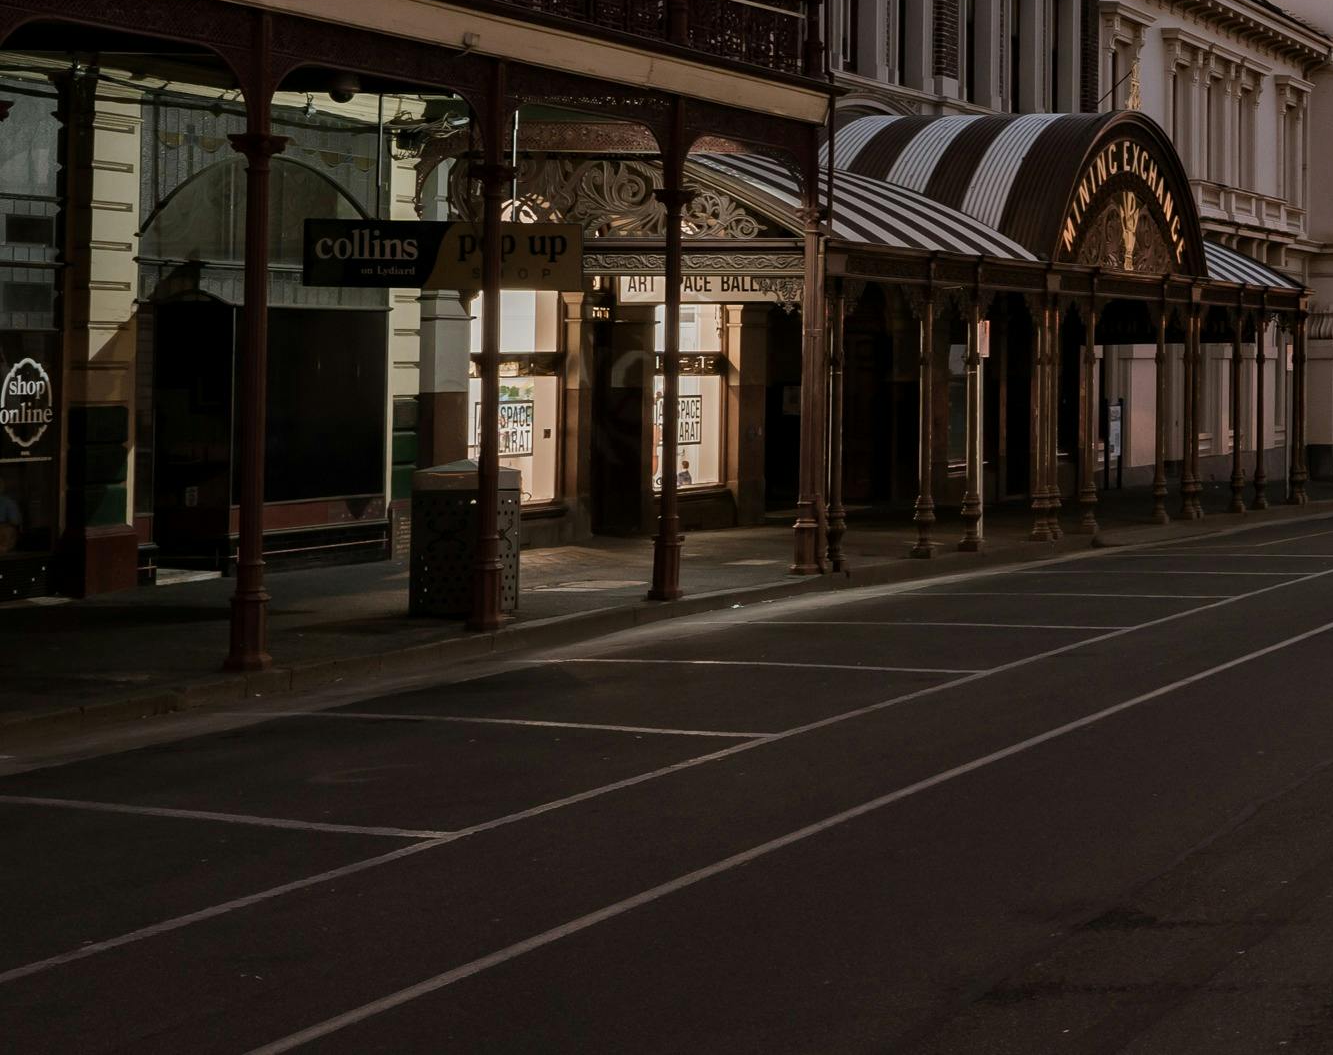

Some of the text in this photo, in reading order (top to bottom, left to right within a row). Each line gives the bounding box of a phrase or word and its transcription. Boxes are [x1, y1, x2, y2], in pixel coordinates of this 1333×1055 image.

[315, 229, 419, 260] collins
[458, 233, 568, 263] pp up
[377, 265, 416, 277] Lydiard
[472, 268, 551, 278] SOP
[627, 276, 655, 293] ART
[680, 276, 712, 292] PACE
[9, 375, 46, 399] shop
[0, 402, 53, 424] online
[500, 406, 532, 429] SPACE
